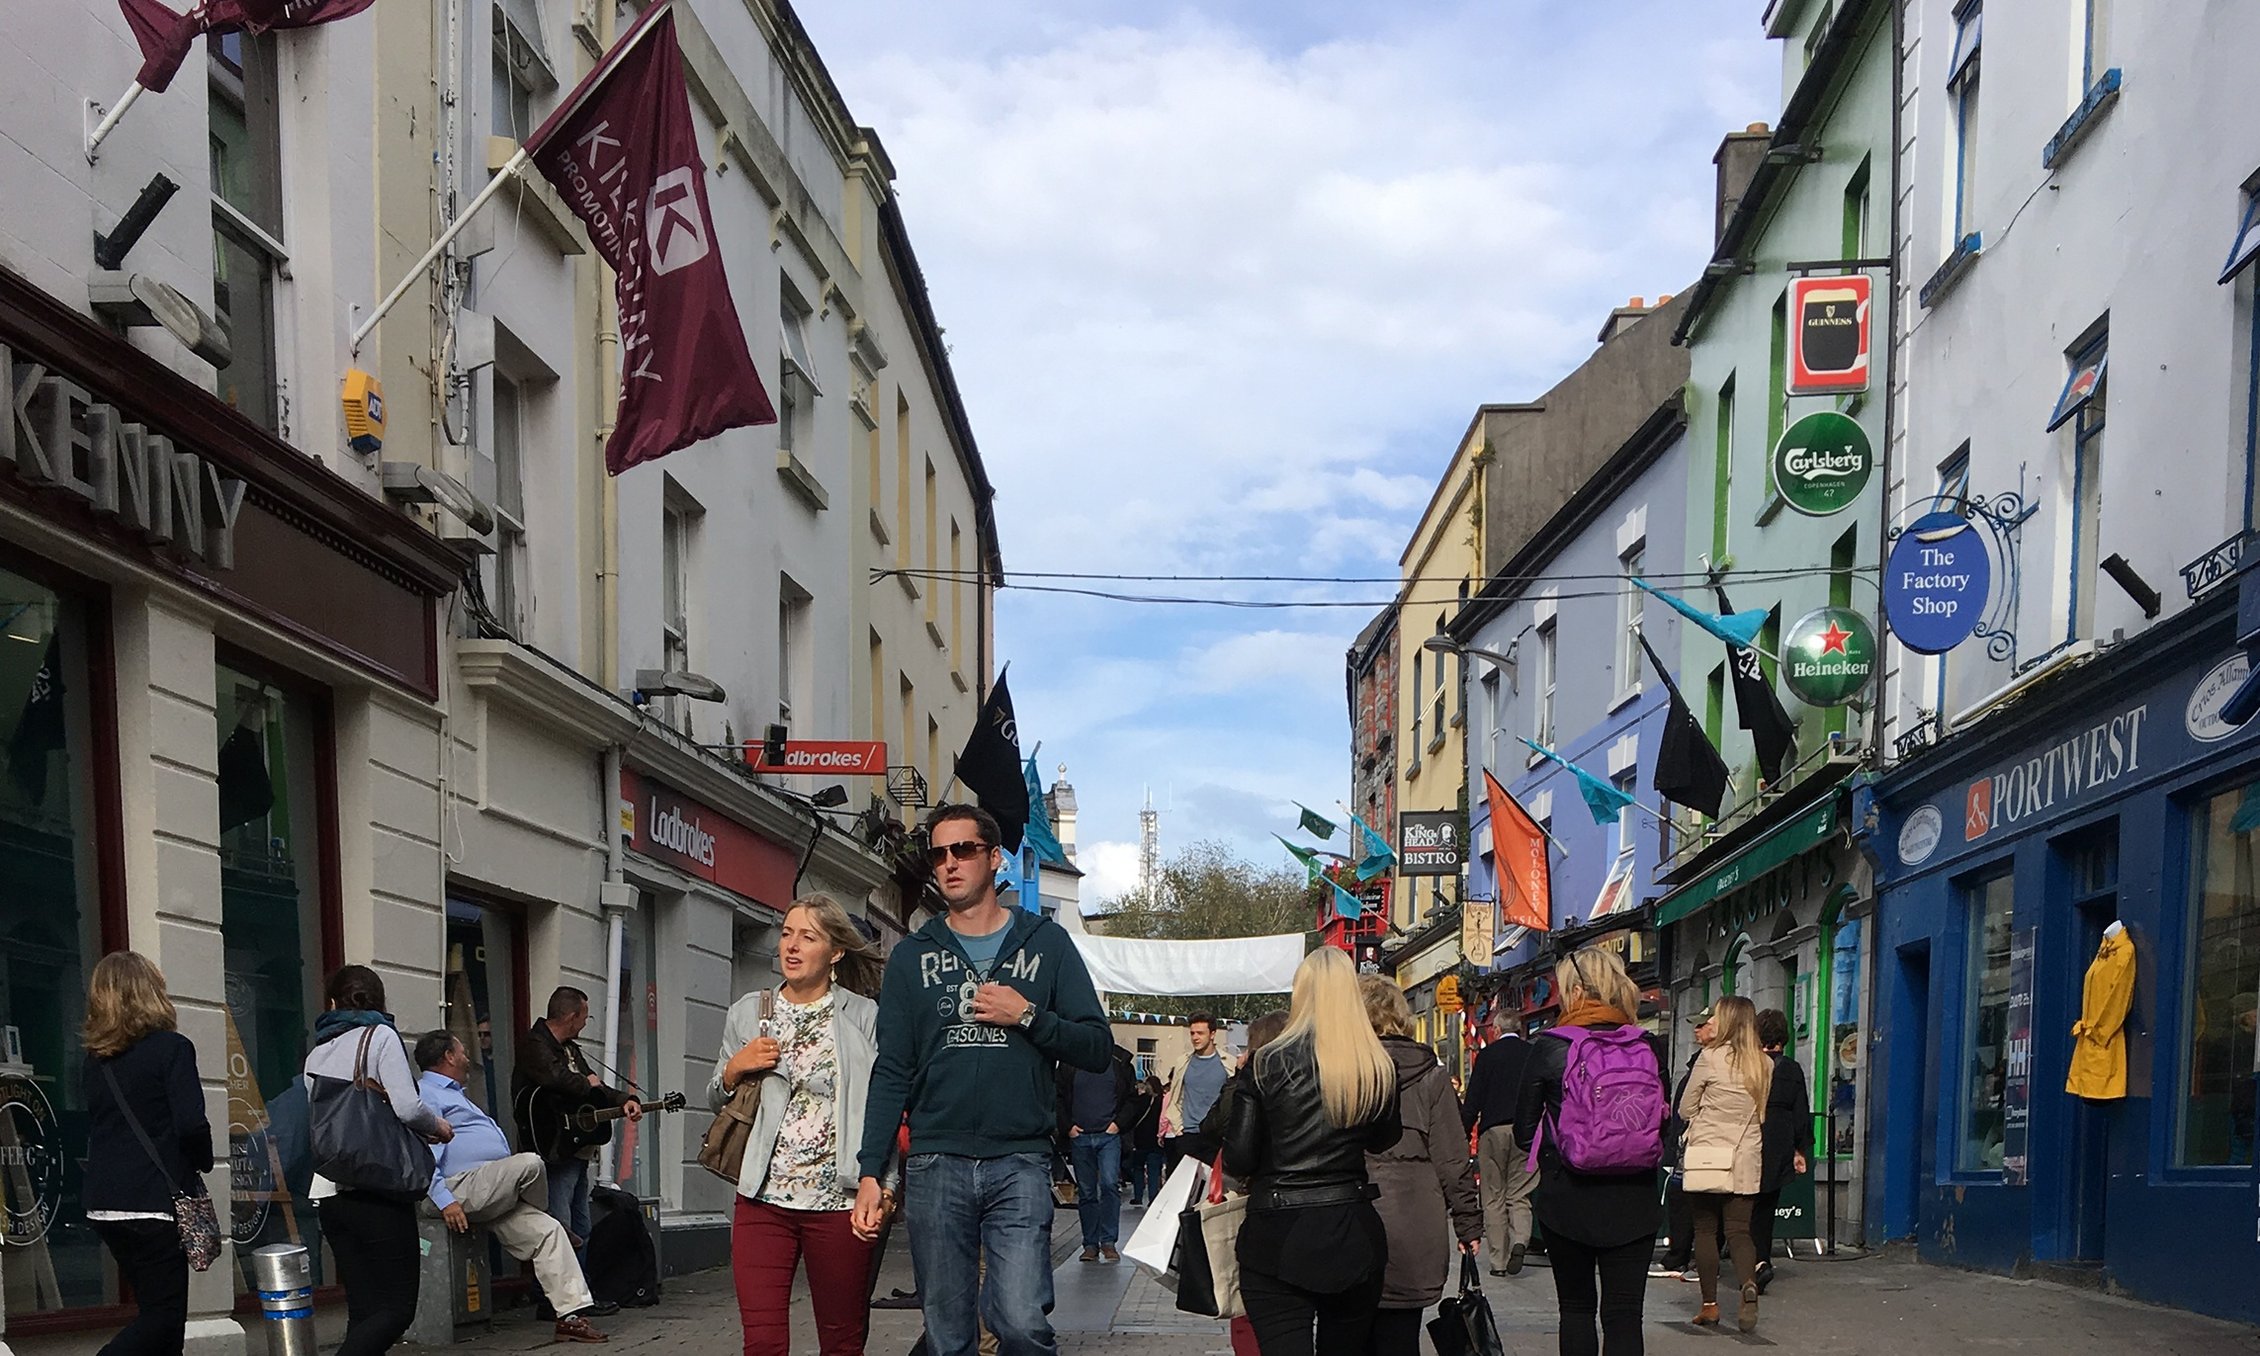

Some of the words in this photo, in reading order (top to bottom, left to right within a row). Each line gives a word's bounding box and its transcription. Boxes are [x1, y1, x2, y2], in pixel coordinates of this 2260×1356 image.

[1808, 317, 1852, 326] GUINNESS
[0, 343, 247, 571] KENNY
[1784, 447, 1863, 476] Carlsberg
[1804, 481, 1845, 489] COPENHAGEN
[1920, 548, 1955, 566] The
[1902, 572, 1970, 592] Factory
[1912, 596, 1958, 618] Shop
[1793, 660, 1869, 678] Heineken
[784, 750, 862, 766] dbrokes
[1990, 705, 2147, 829] PORTWEST
[650, 795, 716, 868] Ladbrokes
[1404, 837, 1434, 847] HEAD
[1404, 852, 1457, 865] BISTRO
[1530, 838, 1541, 912] MOLONEY
[946, 984, 959, 993] EST
[946, 1027, 1007, 1044] GASOLINES
